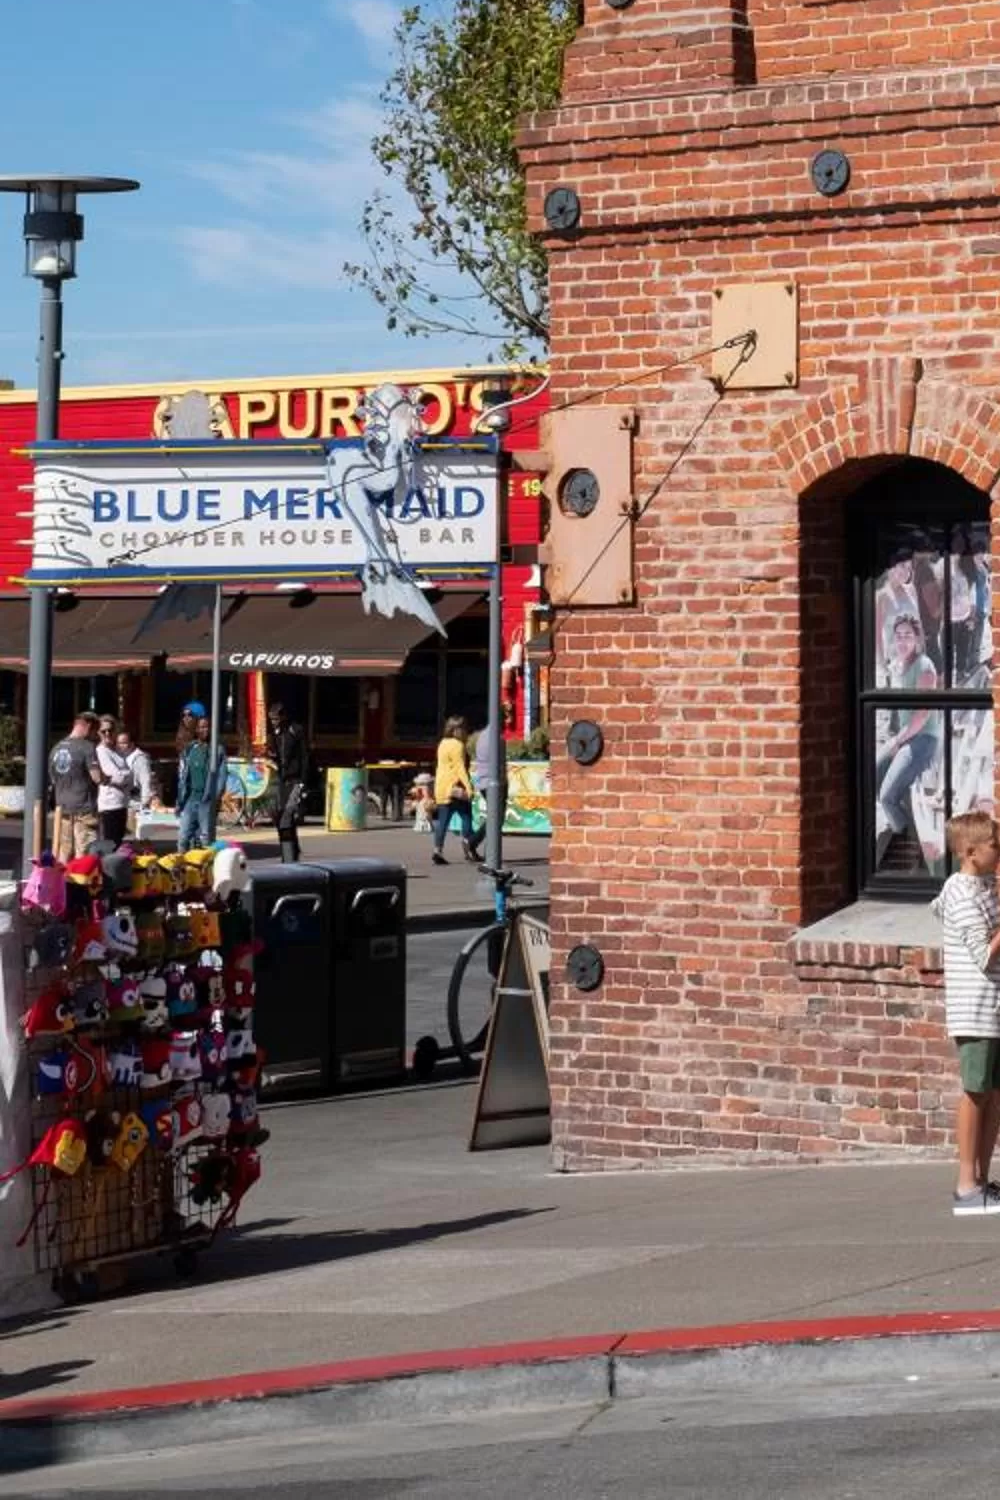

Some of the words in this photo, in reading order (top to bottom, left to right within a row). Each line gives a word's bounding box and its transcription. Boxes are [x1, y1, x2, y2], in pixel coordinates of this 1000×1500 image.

[153, 382, 496, 440] APURO'
[93, 489, 221, 523] BLUE
[99, 529, 245, 548] CHOWDER
[259, 528, 353, 547] HOUSE
[418, 527, 476, 544] BAR
[229, 652, 335, 669] CAPURRO'S
